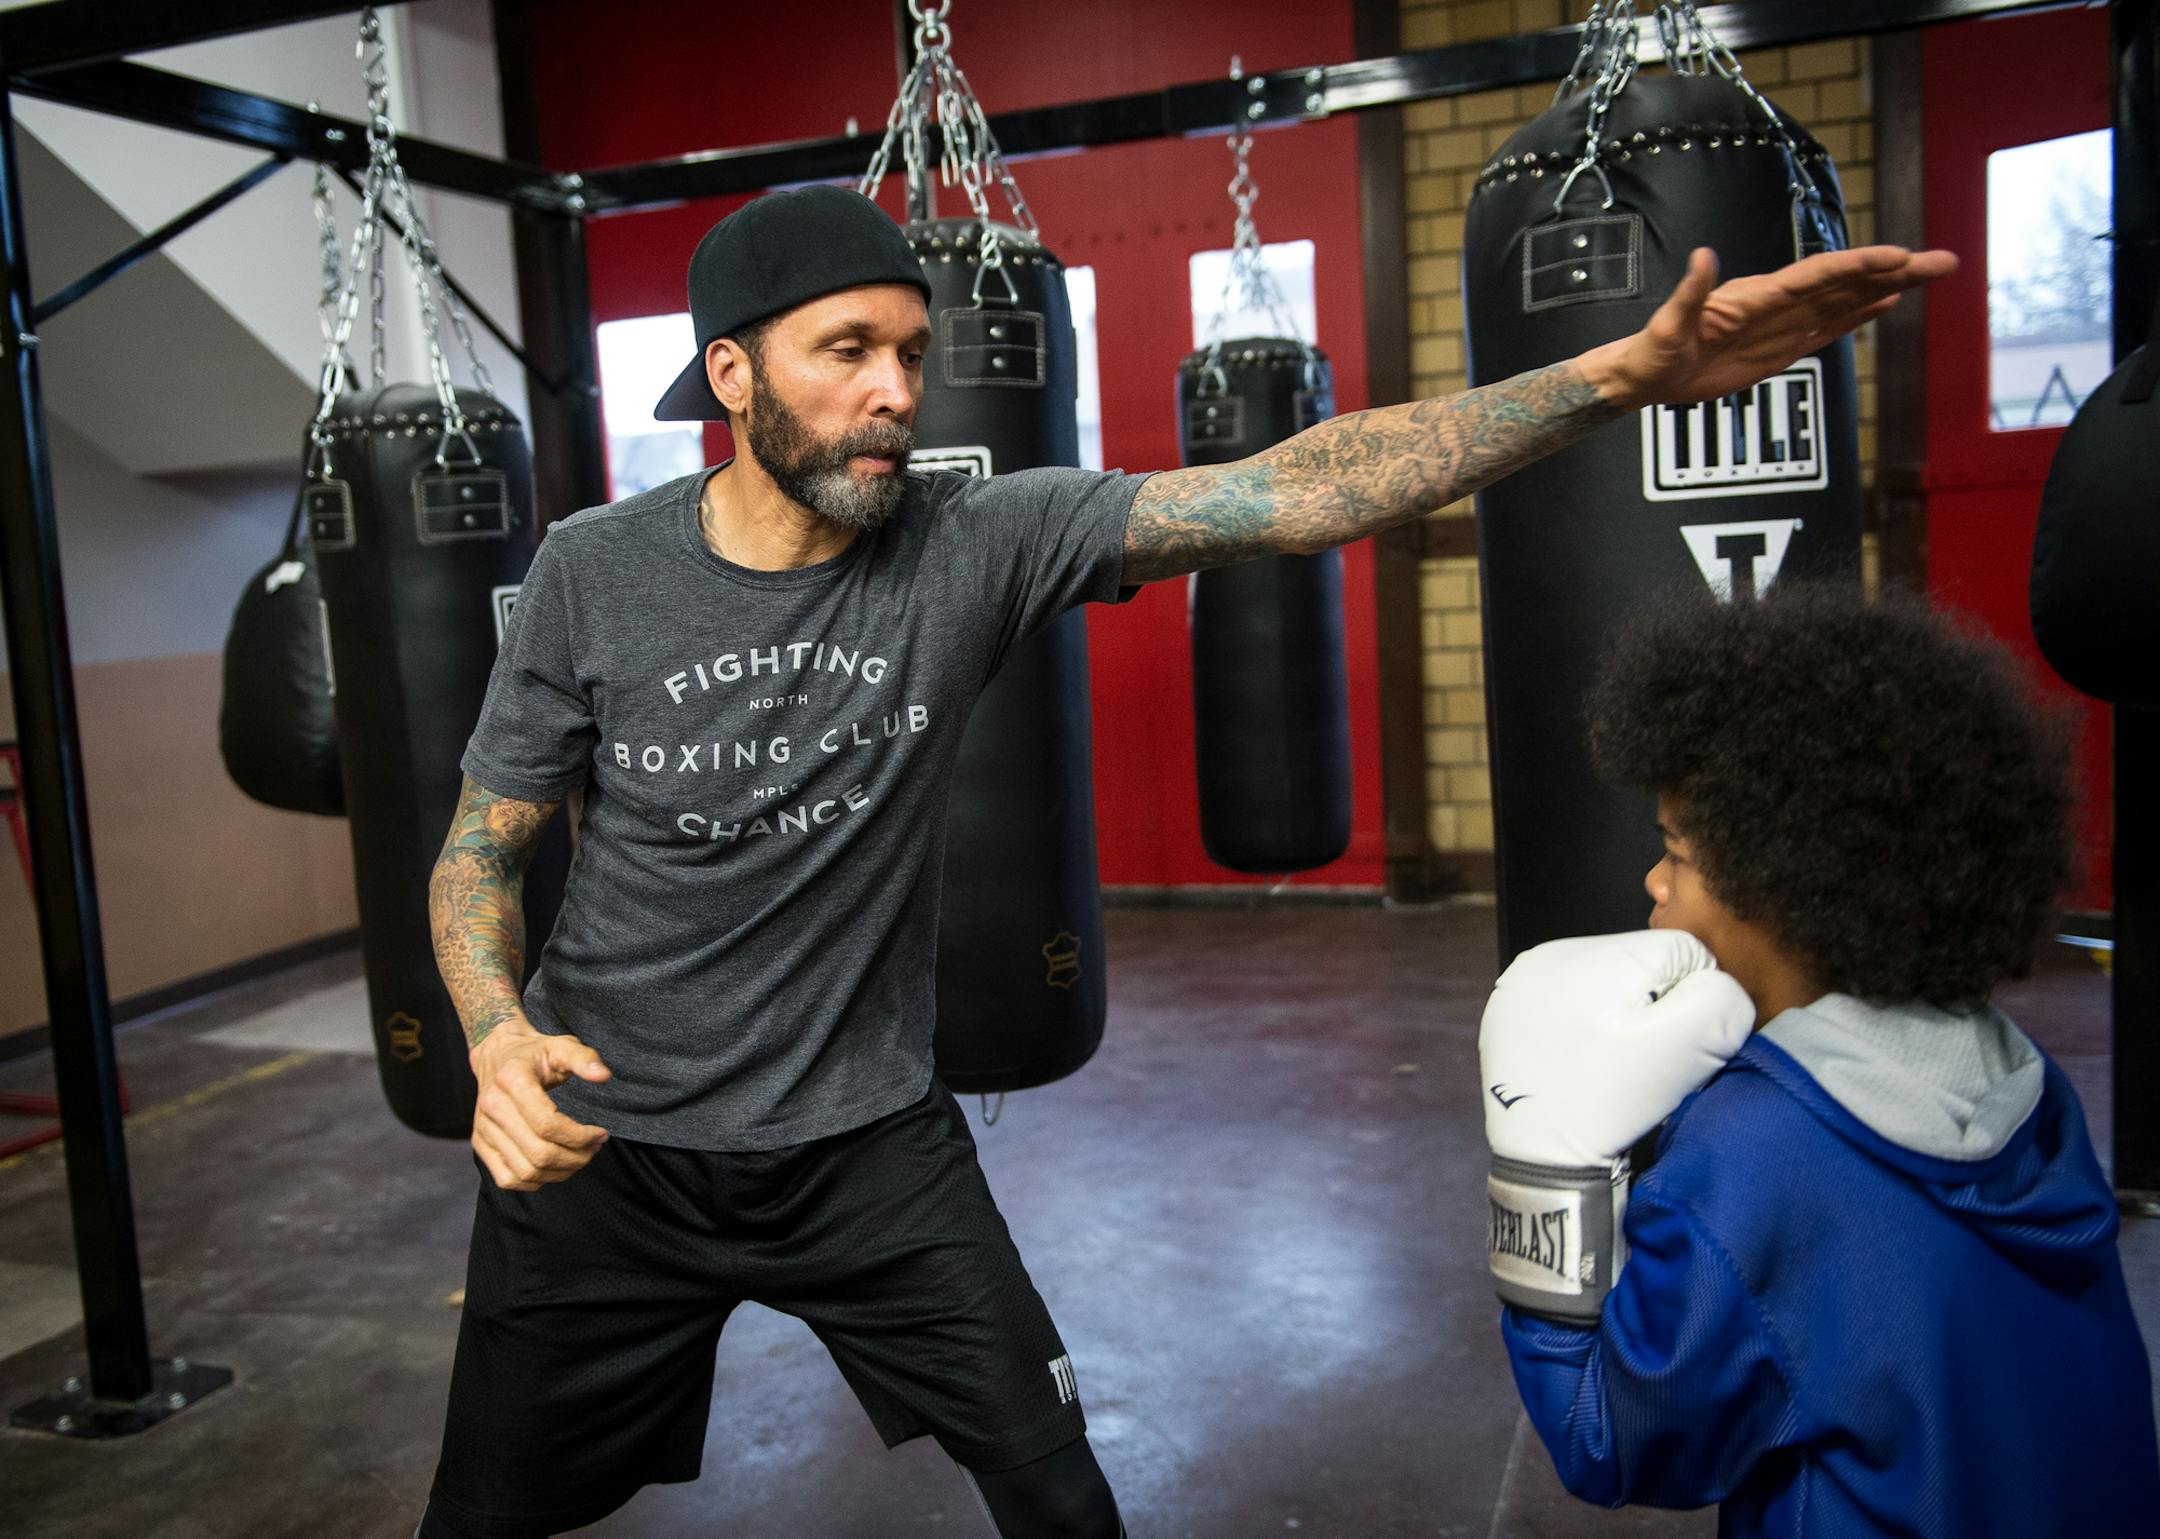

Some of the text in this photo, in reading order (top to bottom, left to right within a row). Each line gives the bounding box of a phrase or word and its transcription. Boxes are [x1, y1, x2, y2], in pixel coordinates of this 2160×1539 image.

[1664, 380, 1812, 469] TITLE
[664, 641, 888, 704] FIGHTING
[750, 694, 808, 710] NORTH
[614, 705, 929, 772] BOXING CLUB
[677, 784, 869, 842] CHANCE
